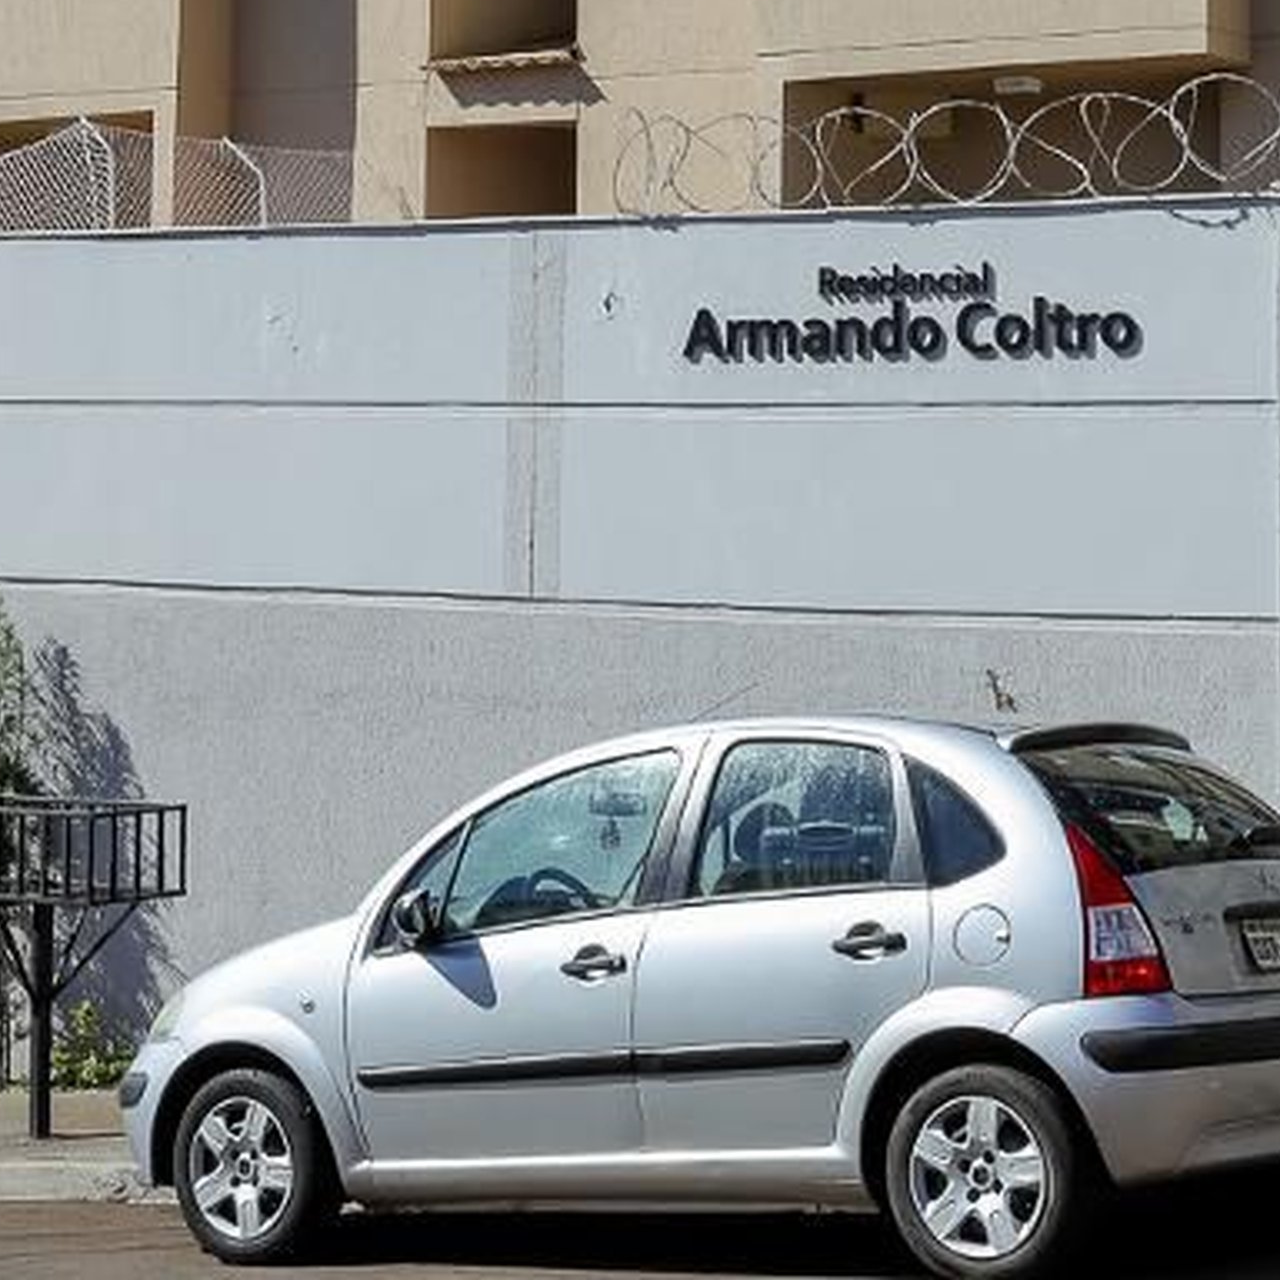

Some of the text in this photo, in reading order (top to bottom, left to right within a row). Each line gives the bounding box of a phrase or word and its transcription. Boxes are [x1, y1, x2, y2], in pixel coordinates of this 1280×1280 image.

[818, 262, 994, 301] Residencial
[683, 297, 1142, 361] Armando Coltro
